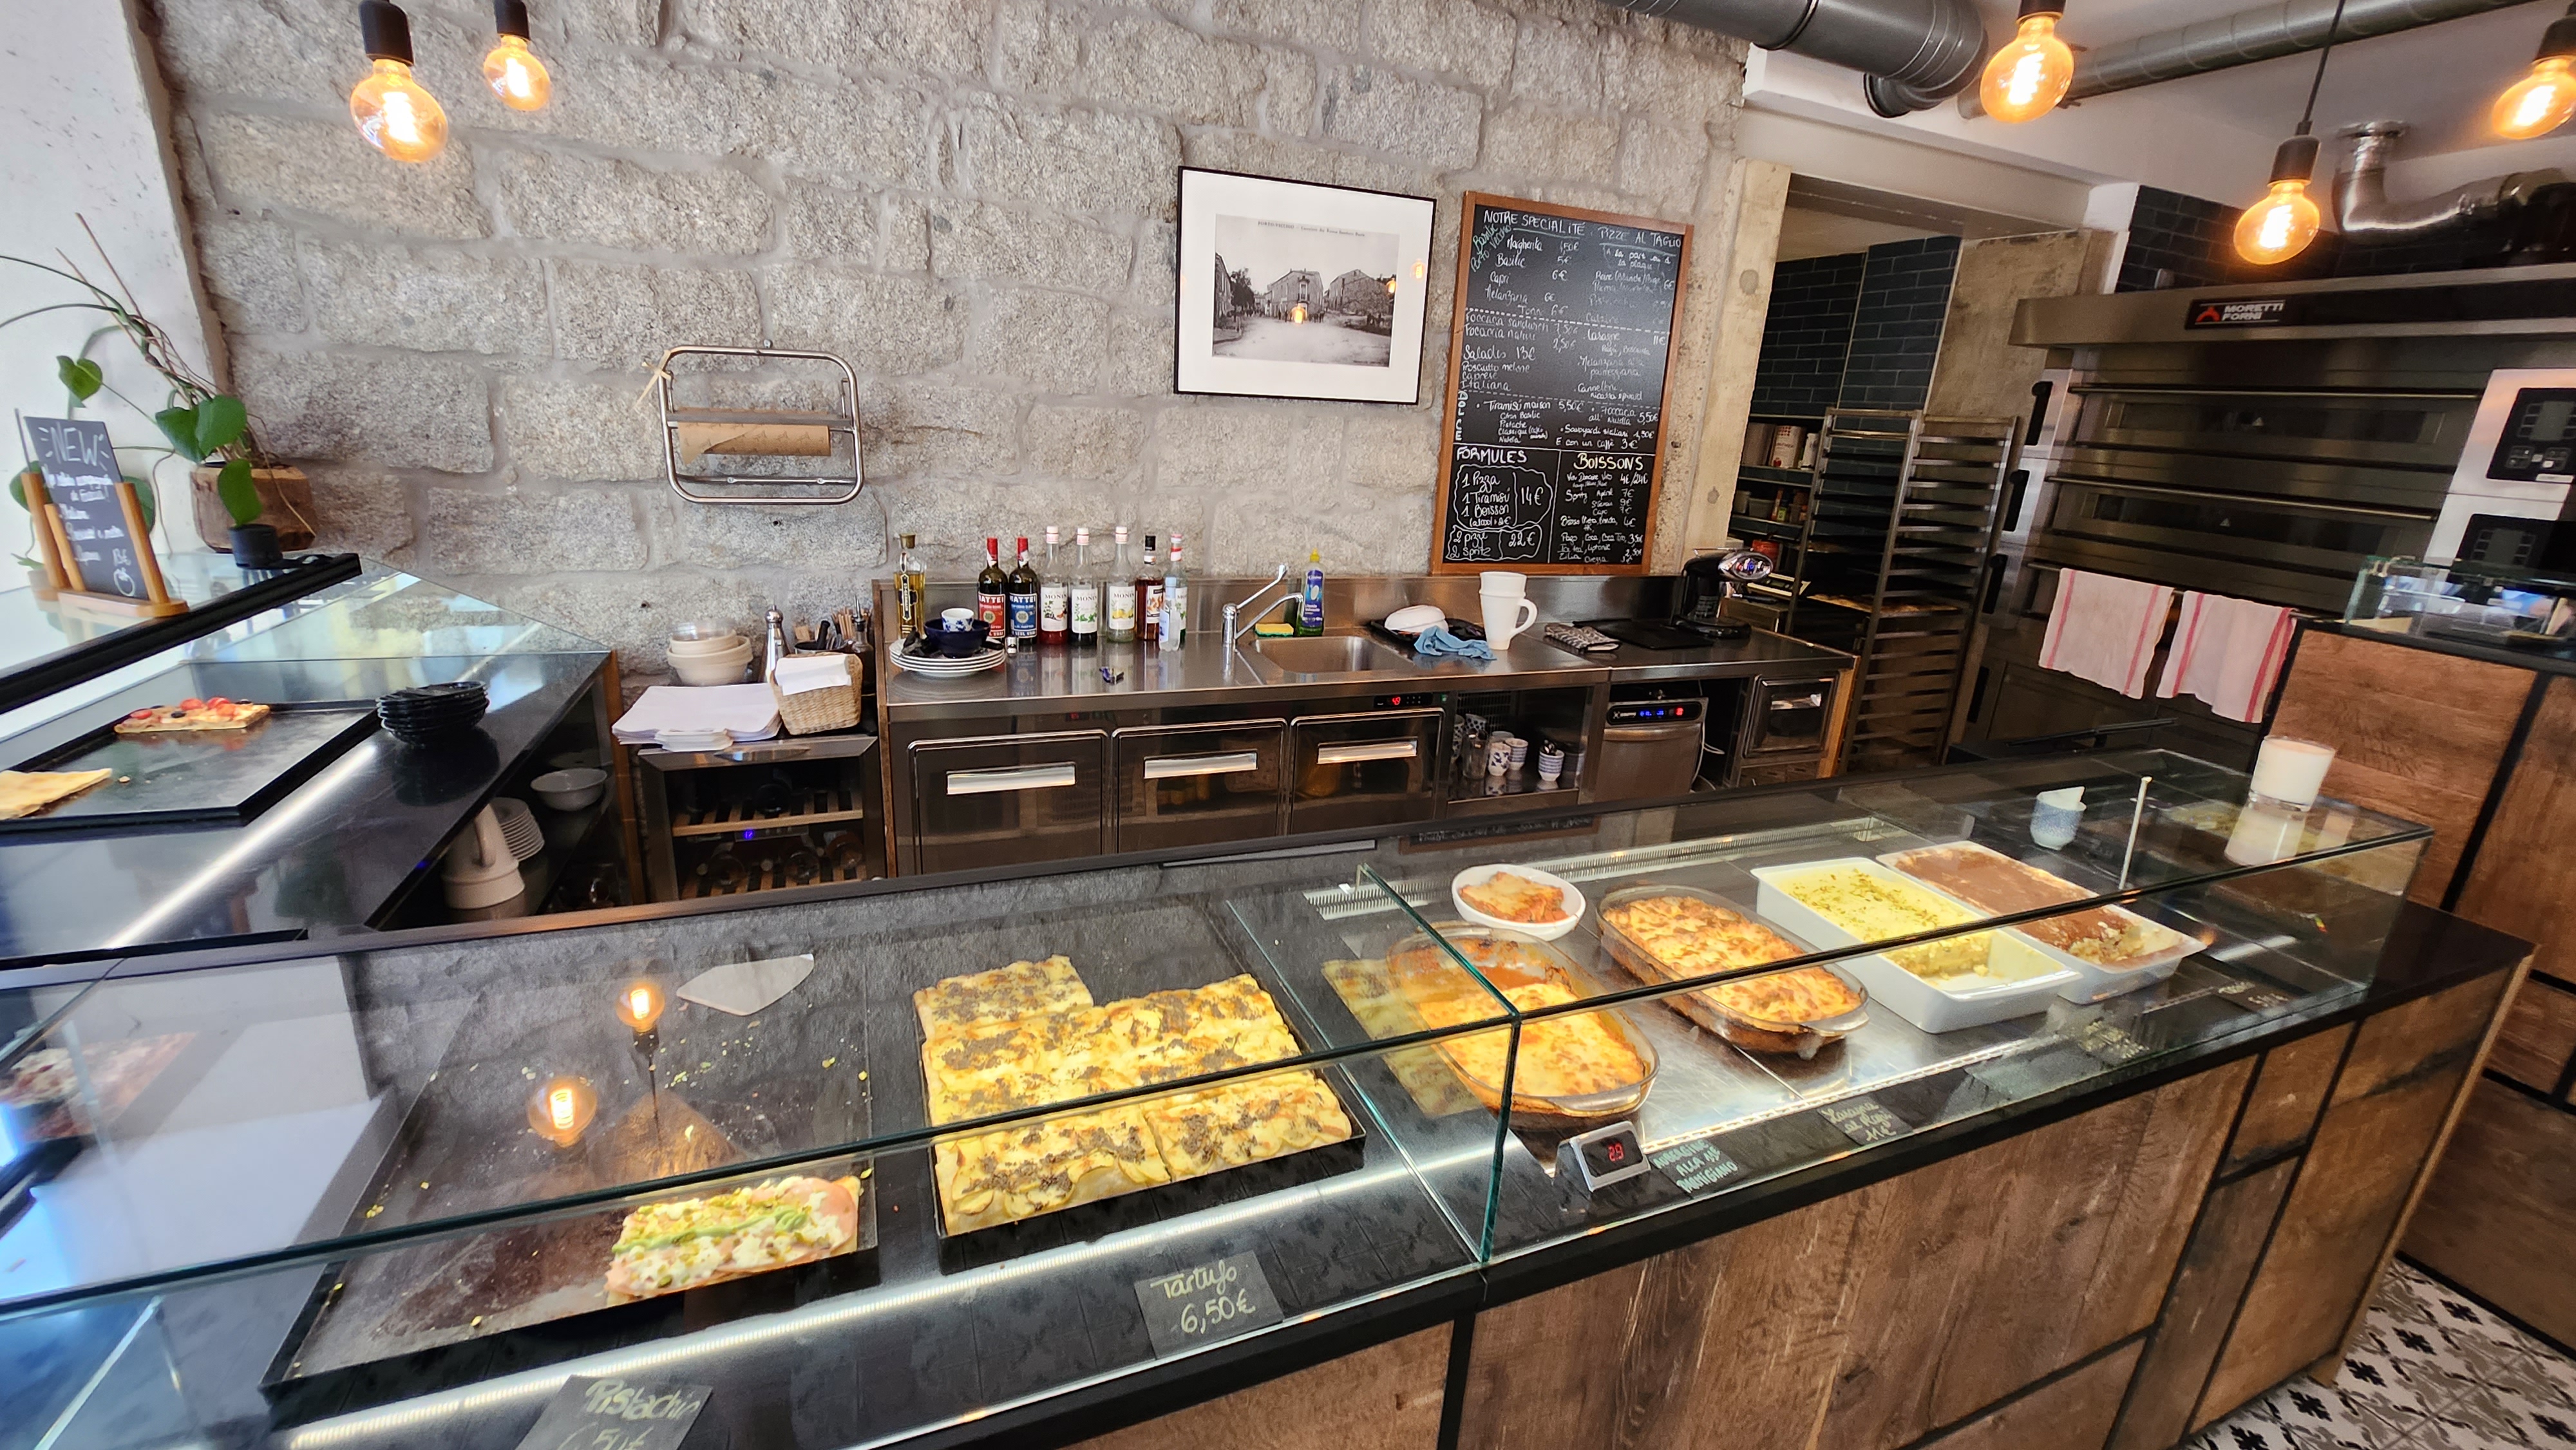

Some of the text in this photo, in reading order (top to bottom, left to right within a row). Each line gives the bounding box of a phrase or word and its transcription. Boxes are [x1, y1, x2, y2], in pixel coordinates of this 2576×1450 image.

[1484, 210, 1518, 225] NOTRE
[1507, 234, 1542, 254] Margherita
[1598, 227, 1681, 248] PIZZE AL TAGLIO
[1557, 256, 1571, 265] 5€
[1490, 269, 1567, 287] Capri 6€
[1544, 292, 1555, 302] 6€
[2225, 303, 2284, 314] MORETTI
[2222, 312, 2262, 321] FORNI
[1653, 335, 1666, 346] 11€
[1463, 344, 1536, 361] Salades 13€
[1462, 361, 1499, 372] Prosciutto
[1462, 371, 1499, 381] Caprese
[1461, 380, 1511, 391] Italiana
[1558, 401, 1584, 412] 5,50€
[50, 422, 97, 466] NEW
[1556, 437, 1562, 446] E
[1621, 438, 1638, 449] 3€
[1457, 447, 1527, 465] FORMULES
[1573, 453, 1643, 471] BOISSONS
[1462, 471, 1501, 493] 1 Pizza
[1462, 493, 1470, 504] 1
[1621, 489, 1634, 498] 7€
[1620, 498, 1632, 507] 9€
[1461, 504, 1509, 518] 1 Boisson
[1454, 531, 1462, 543] 2
[1509, 531, 1535, 546] 22€
[1450, 545, 1459, 558] 2
[1676, 1157, 1705, 1176] ALLA
[1150, 1259, 1236, 1295] Tartufo
[1181, 1288, 1255, 1334] 6,50€
